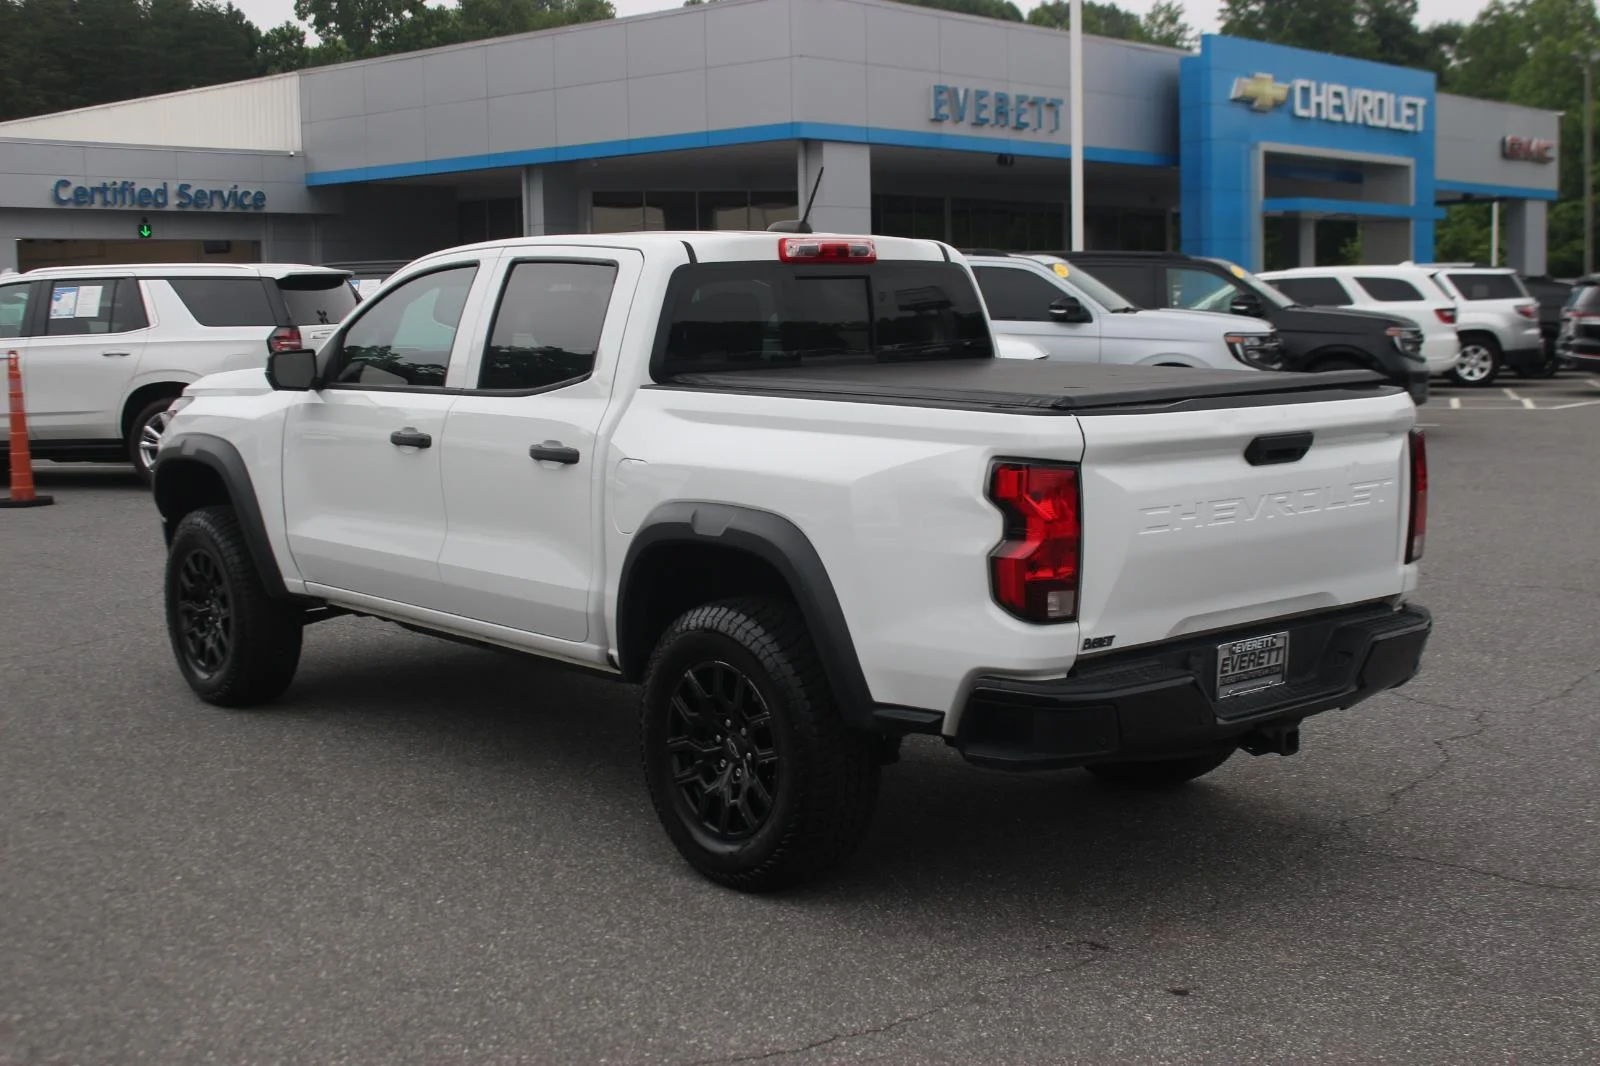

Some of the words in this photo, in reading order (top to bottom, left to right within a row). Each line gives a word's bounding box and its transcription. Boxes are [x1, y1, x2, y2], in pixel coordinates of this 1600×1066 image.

[930, 84, 1064, 131] EVERETT
[1292, 78, 1427, 132] CHEVROLET
[53, 179, 168, 207] Certified
[175, 183, 266, 210] Service
[1138, 477, 1393, 535] CHEVROLET
[1220, 647, 1284, 675] EVERETT
[1235, 636, 1273, 654] EVERETT
